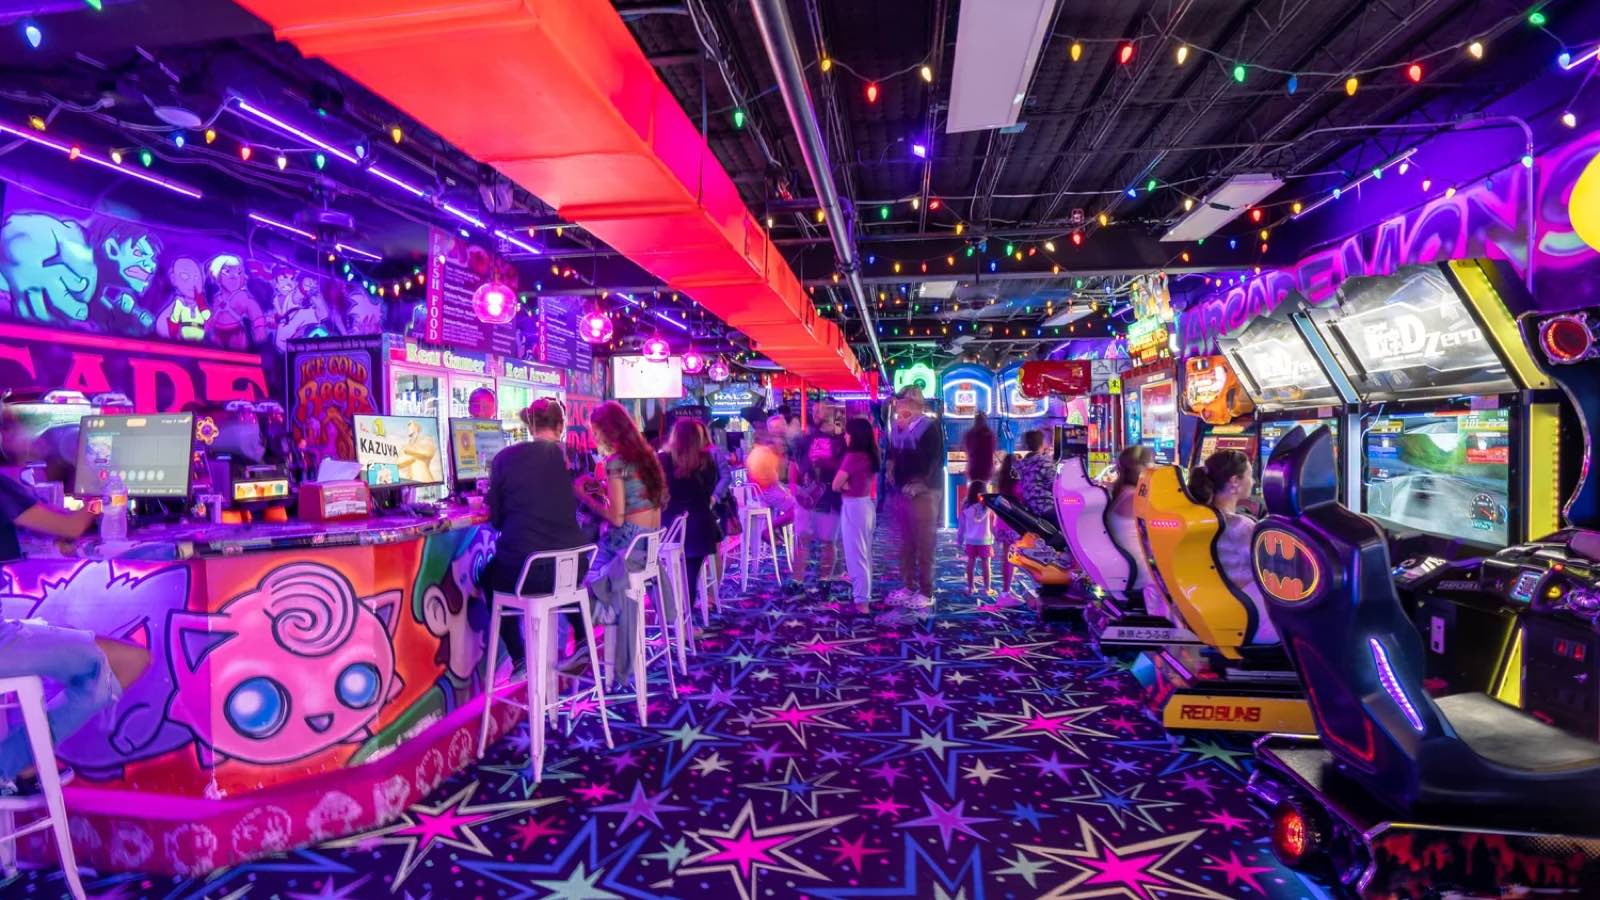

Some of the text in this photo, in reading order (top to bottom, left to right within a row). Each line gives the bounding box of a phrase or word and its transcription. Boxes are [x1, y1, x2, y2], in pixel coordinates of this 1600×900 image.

[429, 233, 440, 340] FRESH FOOD
[405, 343, 441, 367] Real
[328, 356, 368, 382] COLD
[714, 392, 752, 400] HALO
[360, 437, 399, 457] KAZUYA
